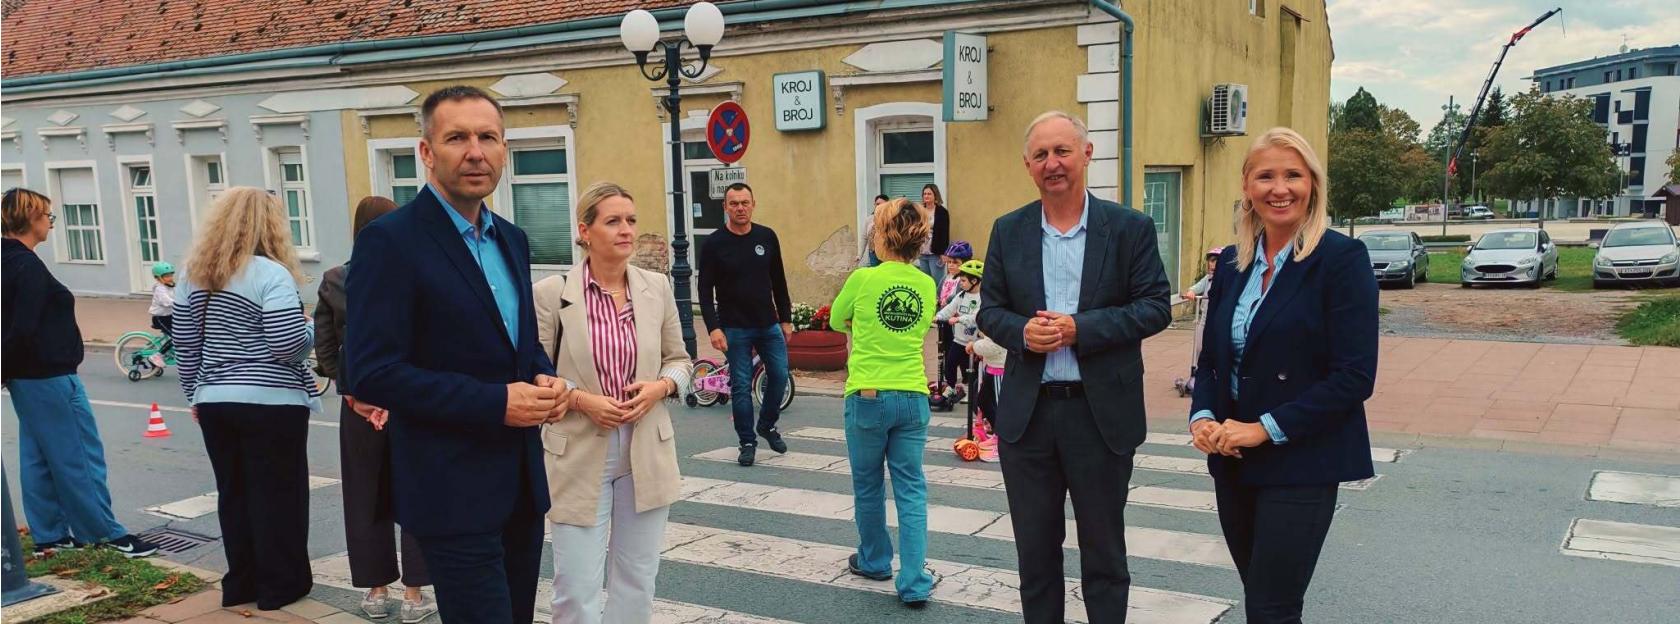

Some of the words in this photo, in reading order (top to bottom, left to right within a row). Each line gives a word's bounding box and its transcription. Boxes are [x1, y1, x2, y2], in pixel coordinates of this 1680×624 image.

[959, 45, 982, 63] KROJ
[967, 70, 973, 85] &
[781, 80, 812, 94] KROJ
[794, 95, 802, 106] &
[959, 92, 982, 109] BROJ
[783, 107, 813, 122] BROJ
[714, 170, 724, 180] Na
